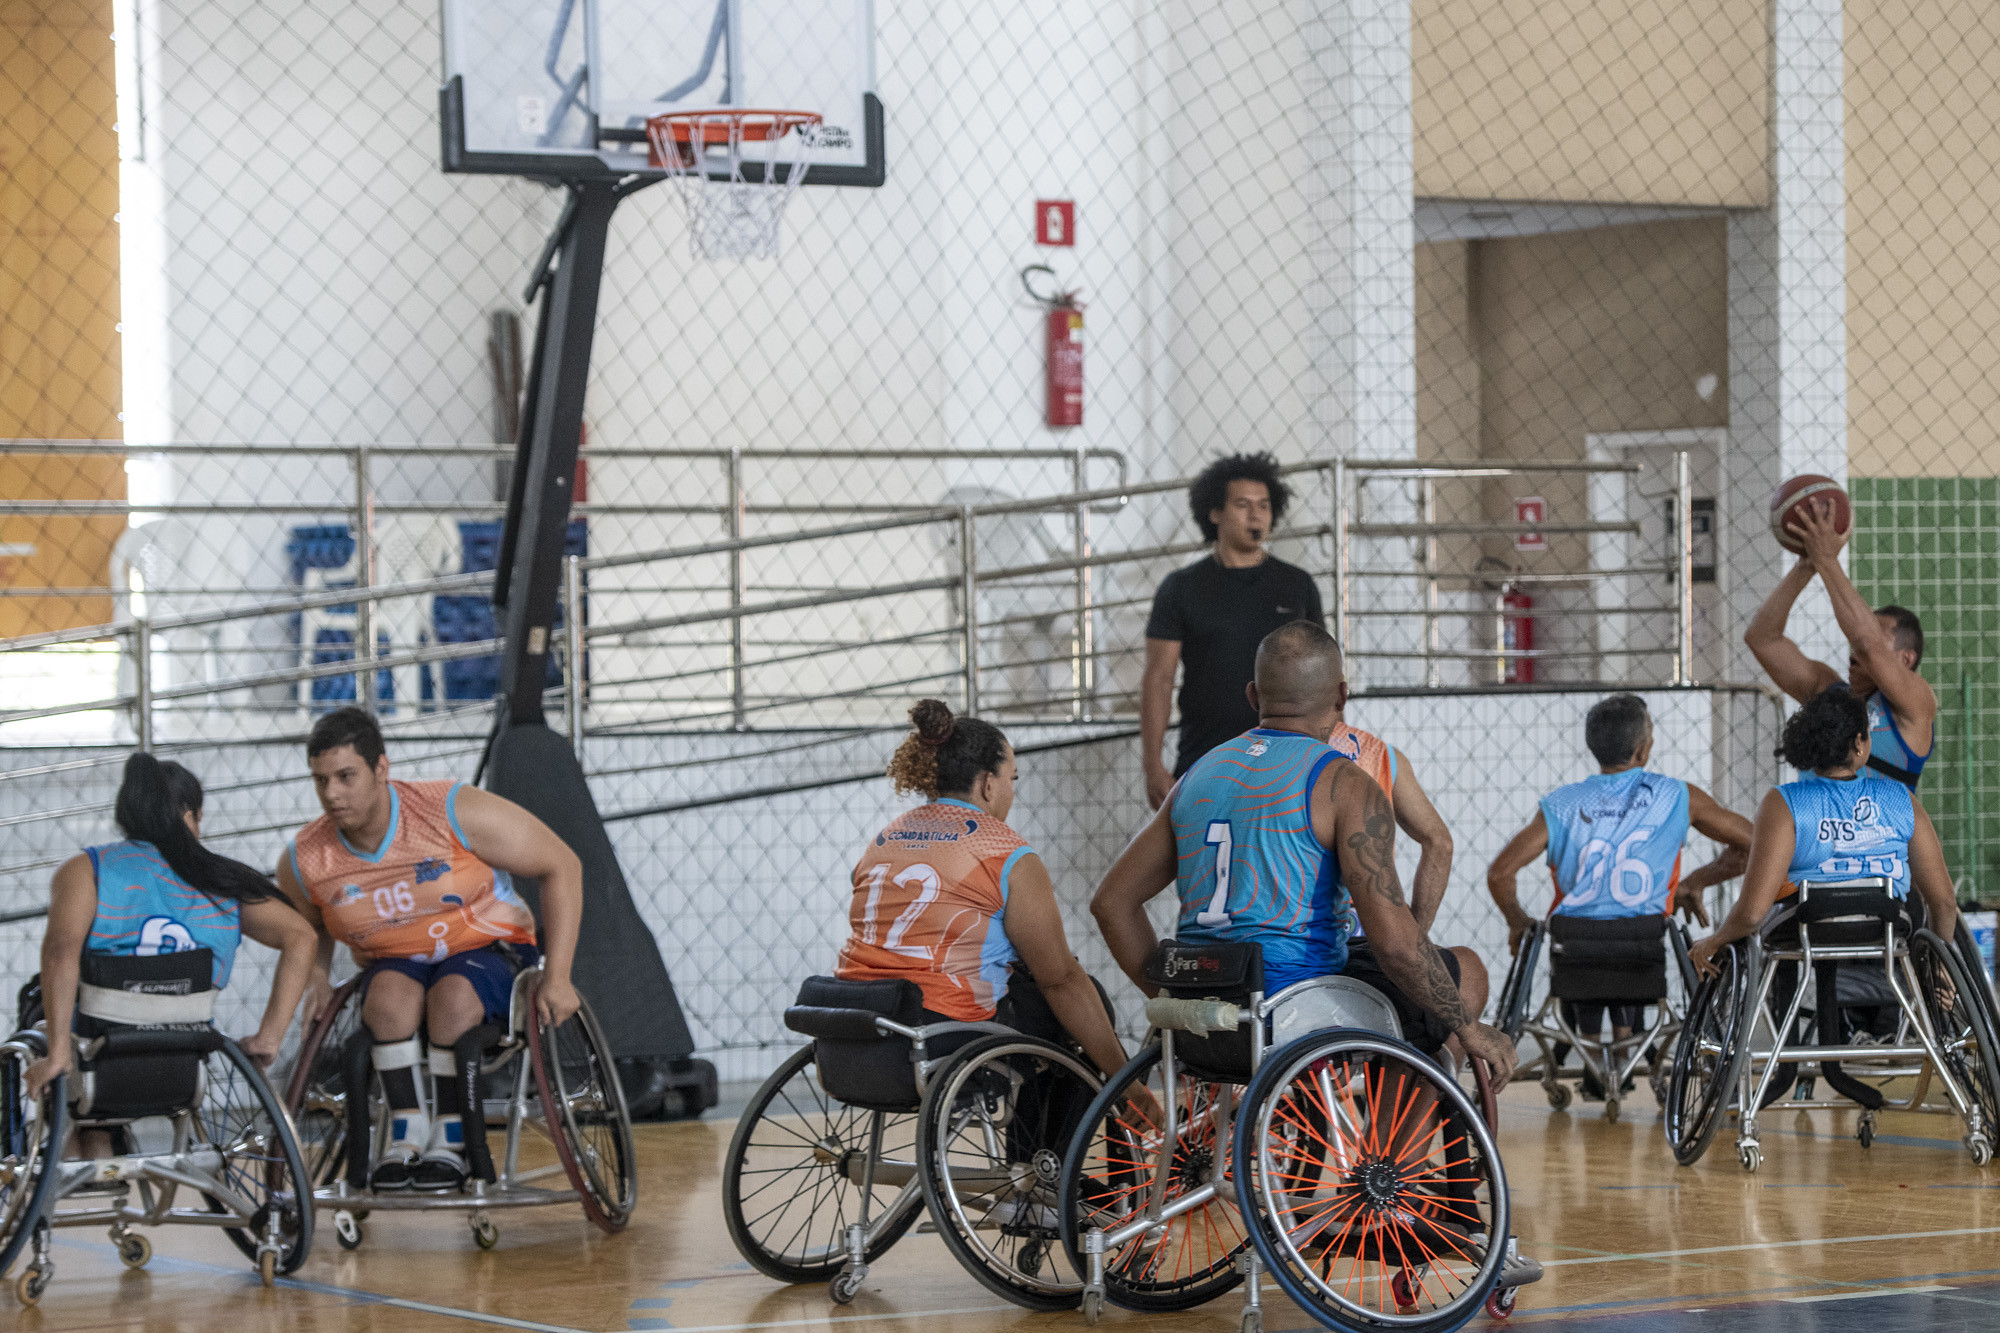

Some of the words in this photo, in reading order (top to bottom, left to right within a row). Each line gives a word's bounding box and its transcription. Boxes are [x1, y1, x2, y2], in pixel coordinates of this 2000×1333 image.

[887, 831, 959, 842] COMPARTILHA
[1819, 820, 1855, 841] SYS
[1196, 820, 1233, 928] 1
[372, 880, 416, 919] 06
[860, 862, 942, 960] 12
[1177, 957, 1219, 972] ParaPlay
